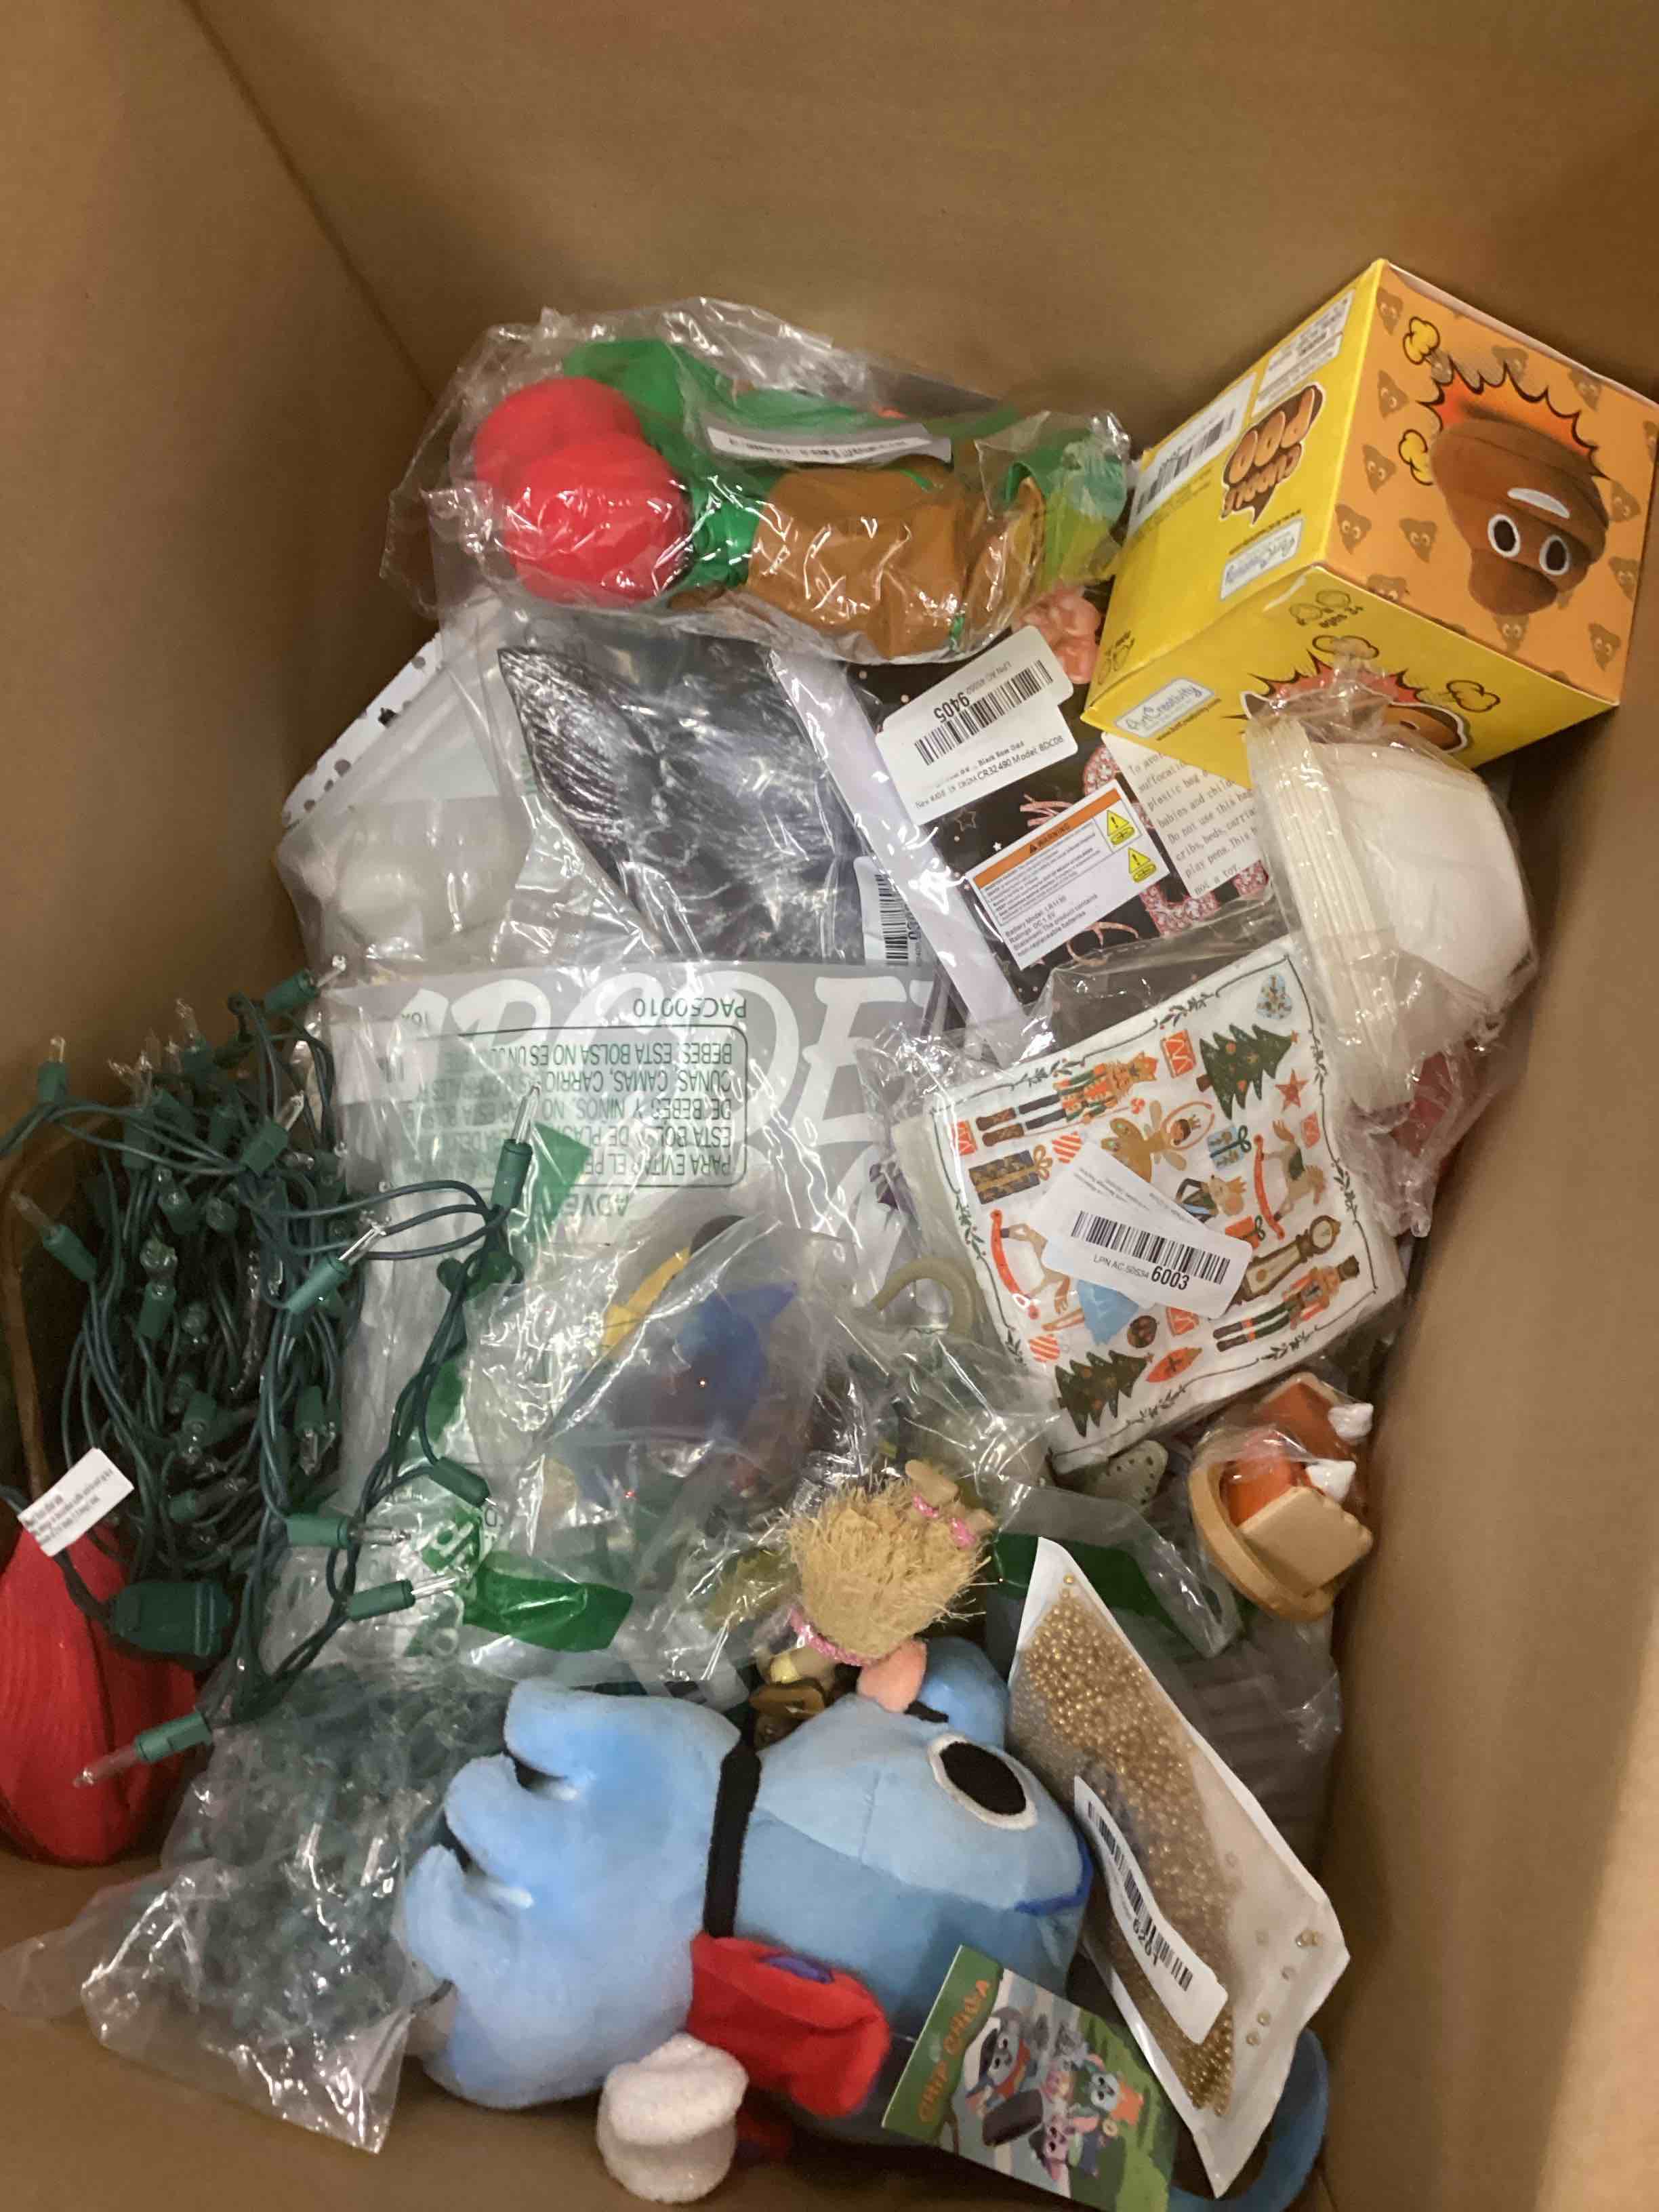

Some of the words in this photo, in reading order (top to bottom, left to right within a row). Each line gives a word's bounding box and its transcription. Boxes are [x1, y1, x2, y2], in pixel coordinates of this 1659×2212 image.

[934, 692, 970, 722] 9405
[1145, 783, 1183, 811] plastic
[1155, 803, 1189, 829] babies
[1186, 792, 1206, 810] and
[1166, 830, 1181, 844] Do
[1181, 822, 1197, 836] not
[1197, 811, 1215, 825] use
[1214, 797, 1236, 815] this
[1183, 858, 1206, 878] play
[1229, 830, 1250, 848] This
[634, 998, 745, 1018] PAC50010
[531, 1044, 548, 1066] ES
[553, 1044, 575, 1065] NO
[581, 1043, 630, 1065] BOLSA
[636, 1043, 672, 1065] ESTA
[610, 1069, 668, 1092] CAMAS,
[543, 1099, 565, 1120] NO
[712, 1098, 731, 1120] DE
[609, 1126, 630, 1148] DE
[694, 1126, 731, 1148] ESTA
[608, 1154, 627, 1176] EL
[690, 1154, 731, 1176] PARA
[1151, 1266, 1190, 1291] 6003
